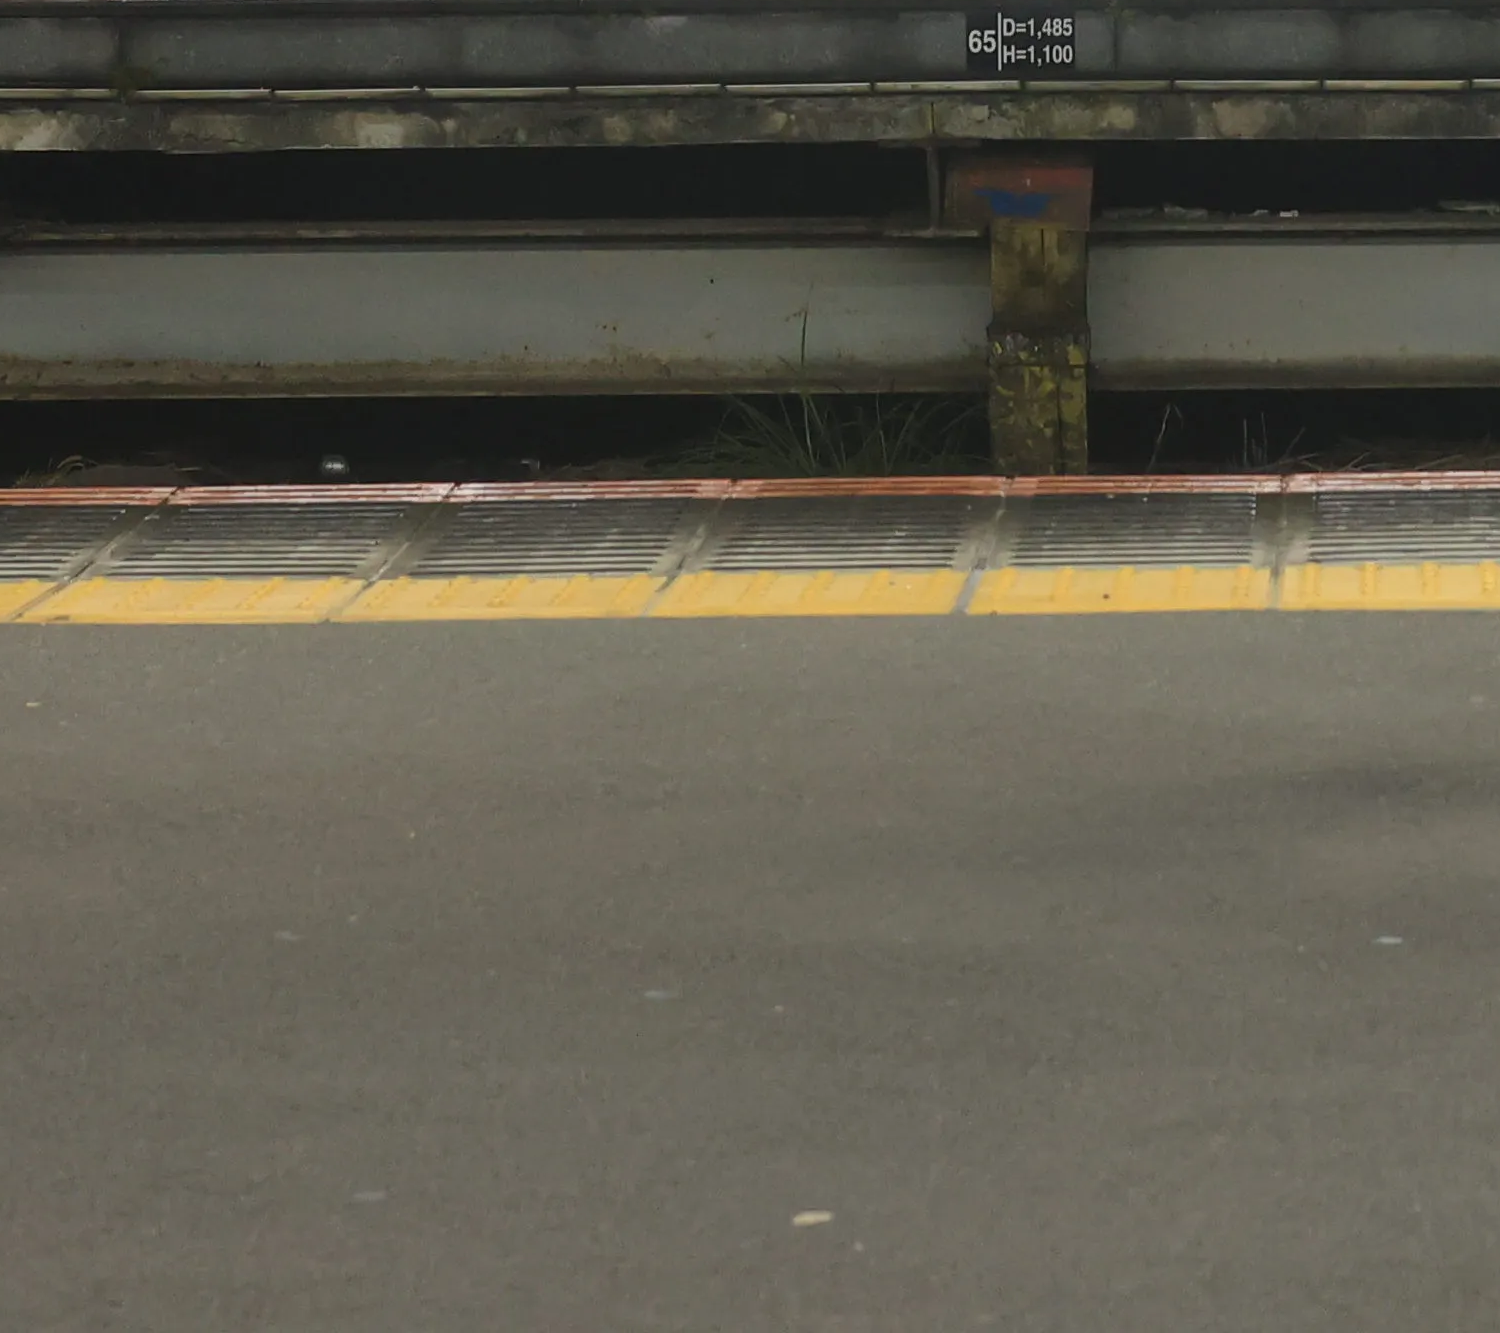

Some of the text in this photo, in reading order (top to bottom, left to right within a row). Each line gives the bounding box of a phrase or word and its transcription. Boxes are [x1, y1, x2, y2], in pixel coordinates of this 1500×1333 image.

[1003, 18, 1074, 40] D=1,485
[968, 29, 997, 53] 65
[1003, 45, 1074, 67] H=1,100
